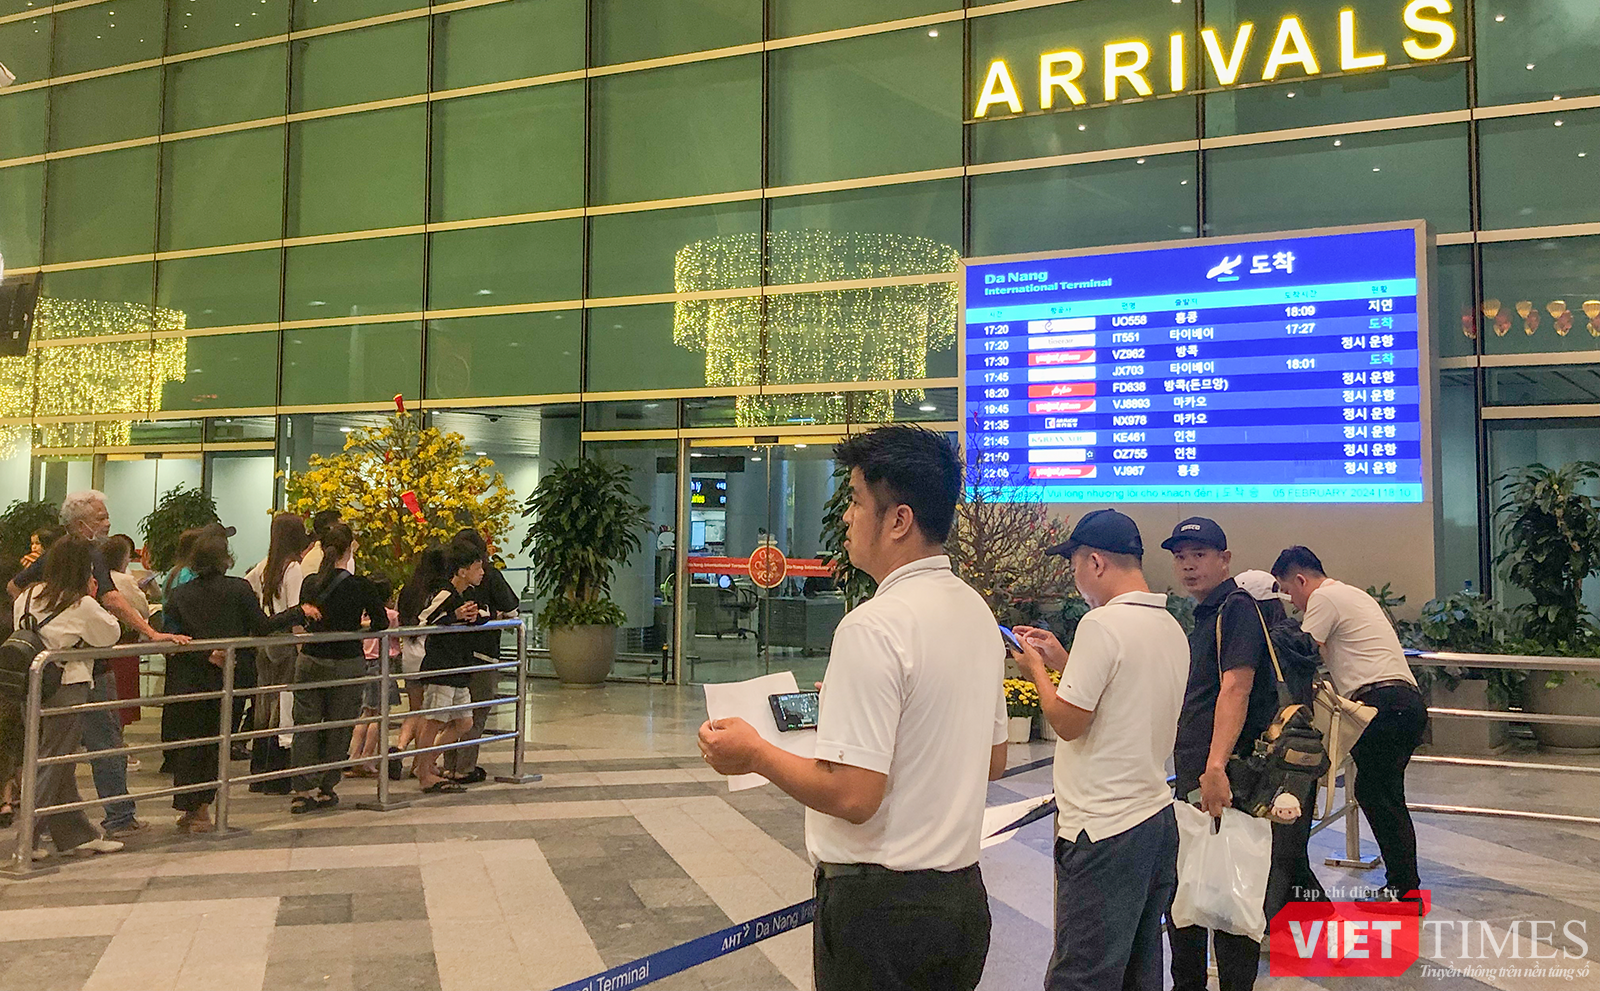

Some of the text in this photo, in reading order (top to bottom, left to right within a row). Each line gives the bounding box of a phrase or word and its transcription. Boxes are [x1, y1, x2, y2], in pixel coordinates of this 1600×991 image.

[973, 0, 1457, 119] ARRIVALS
[1249, 251, 1296, 275] 도착
[984, 271, 1048, 284] Da Nang
[984, 278, 1112, 296] International Terminal
[1284, 305, 1316, 317] 18:09
[1368, 298, 1393, 312] 지연
[1112, 314, 1147, 327] UO558
[1368, 316, 1394, 330] 도착
[984, 324, 1009, 335] 17:20
[1169, 327, 1214, 341] 타이베이
[1285, 322, 1316, 335] 17:27
[1112, 332, 1140, 343] IT551
[1341, 334, 1394, 350] 정시 운항
[984, 340, 1009, 351] 17:20
[1175, 344, 1199, 358] 방콕
[1111, 348, 1145, 360] VZ962
[1369, 352, 1395, 366] 도착
[984, 356, 1009, 367] 17:30
[1169, 361, 1214, 375] 타이베이
[1286, 358, 1315, 370] 18:01
[984, 371, 1009, 383] 17:45
[1112, 365, 1144, 376] JX703
[1342, 370, 1395, 385] 정시 운항
[984, 388, 1009, 399] 18:20
[1342, 388, 1396, 403] 정시 운항
[984, 403, 1009, 414] 19:45
[1173, 396, 1207, 409] 마카오
[1173, 412, 1208, 426] 마카오
[1342, 406, 1396, 421] 정시 운항
[983, 419, 1010, 431] 21:35
[1113, 415, 1148, 426] NX978
[1113, 432, 1145, 443] KE461
[1174, 430, 1196, 443] 인천
[1343, 424, 1396, 439] 정시 운항
[983, 435, 1010, 446] 21:45
[1113, 448, 1148, 460] OZ755
[1174, 447, 1196, 460] 인천
[1343, 443, 1397, 457] 정시 운항
[1113, 465, 1145, 476] VJ967
[1344, 461, 1397, 475] 정시 운항
[1141, 489, 1159, 498] cho
[1272, 489, 1285, 498] 05
[1288, 489, 1347, 498] FEBRUARY
[1350, 489, 1375, 498] 2024
[720, 912, 799, 952] AHT Da Nang
[596, 960, 650, 991] Terminal
